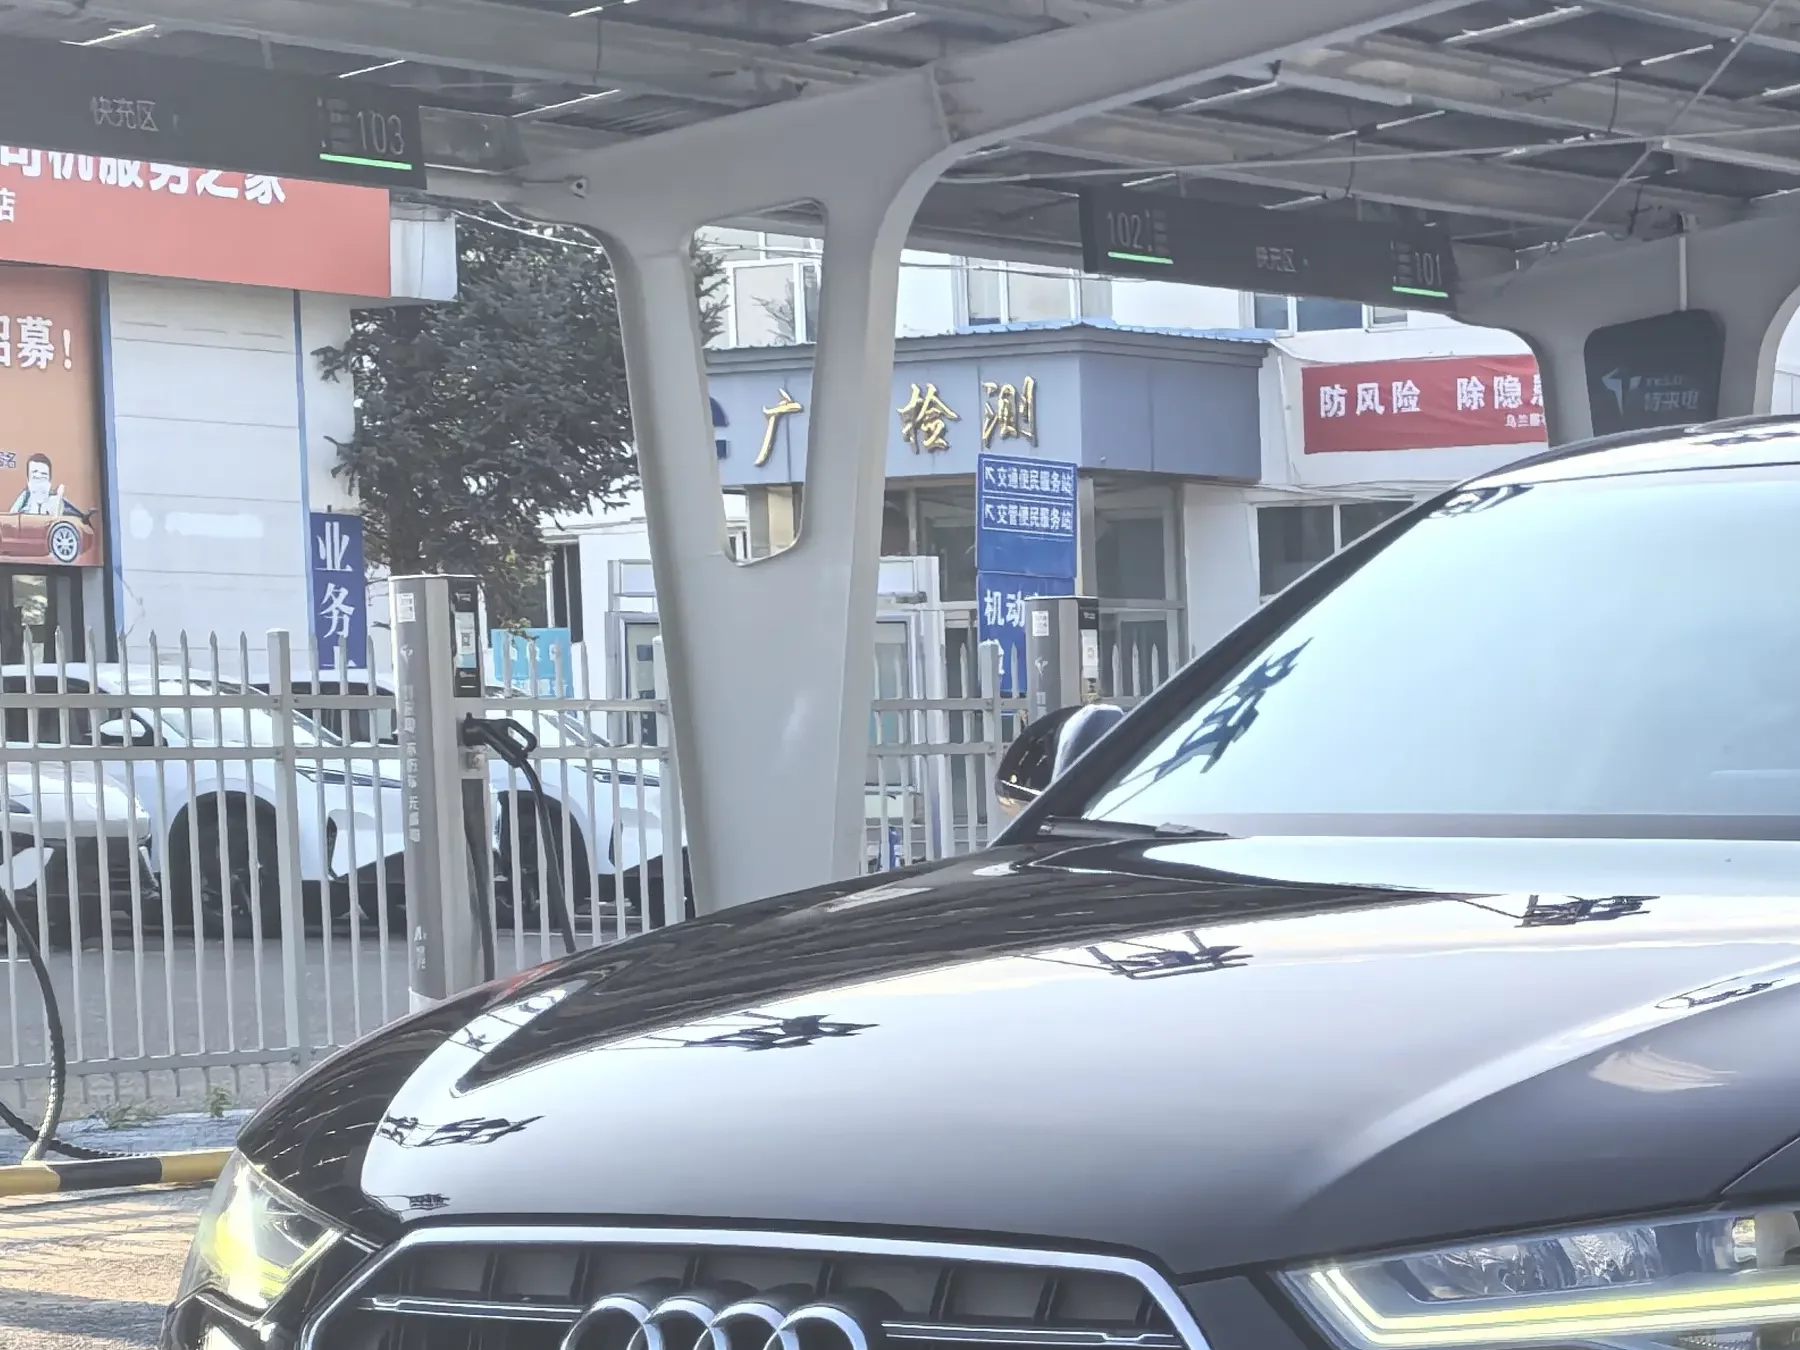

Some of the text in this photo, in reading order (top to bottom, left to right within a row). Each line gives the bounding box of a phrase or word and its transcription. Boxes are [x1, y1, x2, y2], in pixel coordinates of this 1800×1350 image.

[89, 95, 160, 132] 快充区
[356, 111, 405, 155] 103
[1107, 211, 1144, 249] 102
[1414, 251, 1443, 286] 101
[1319, 379, 1421, 418] 防风险
